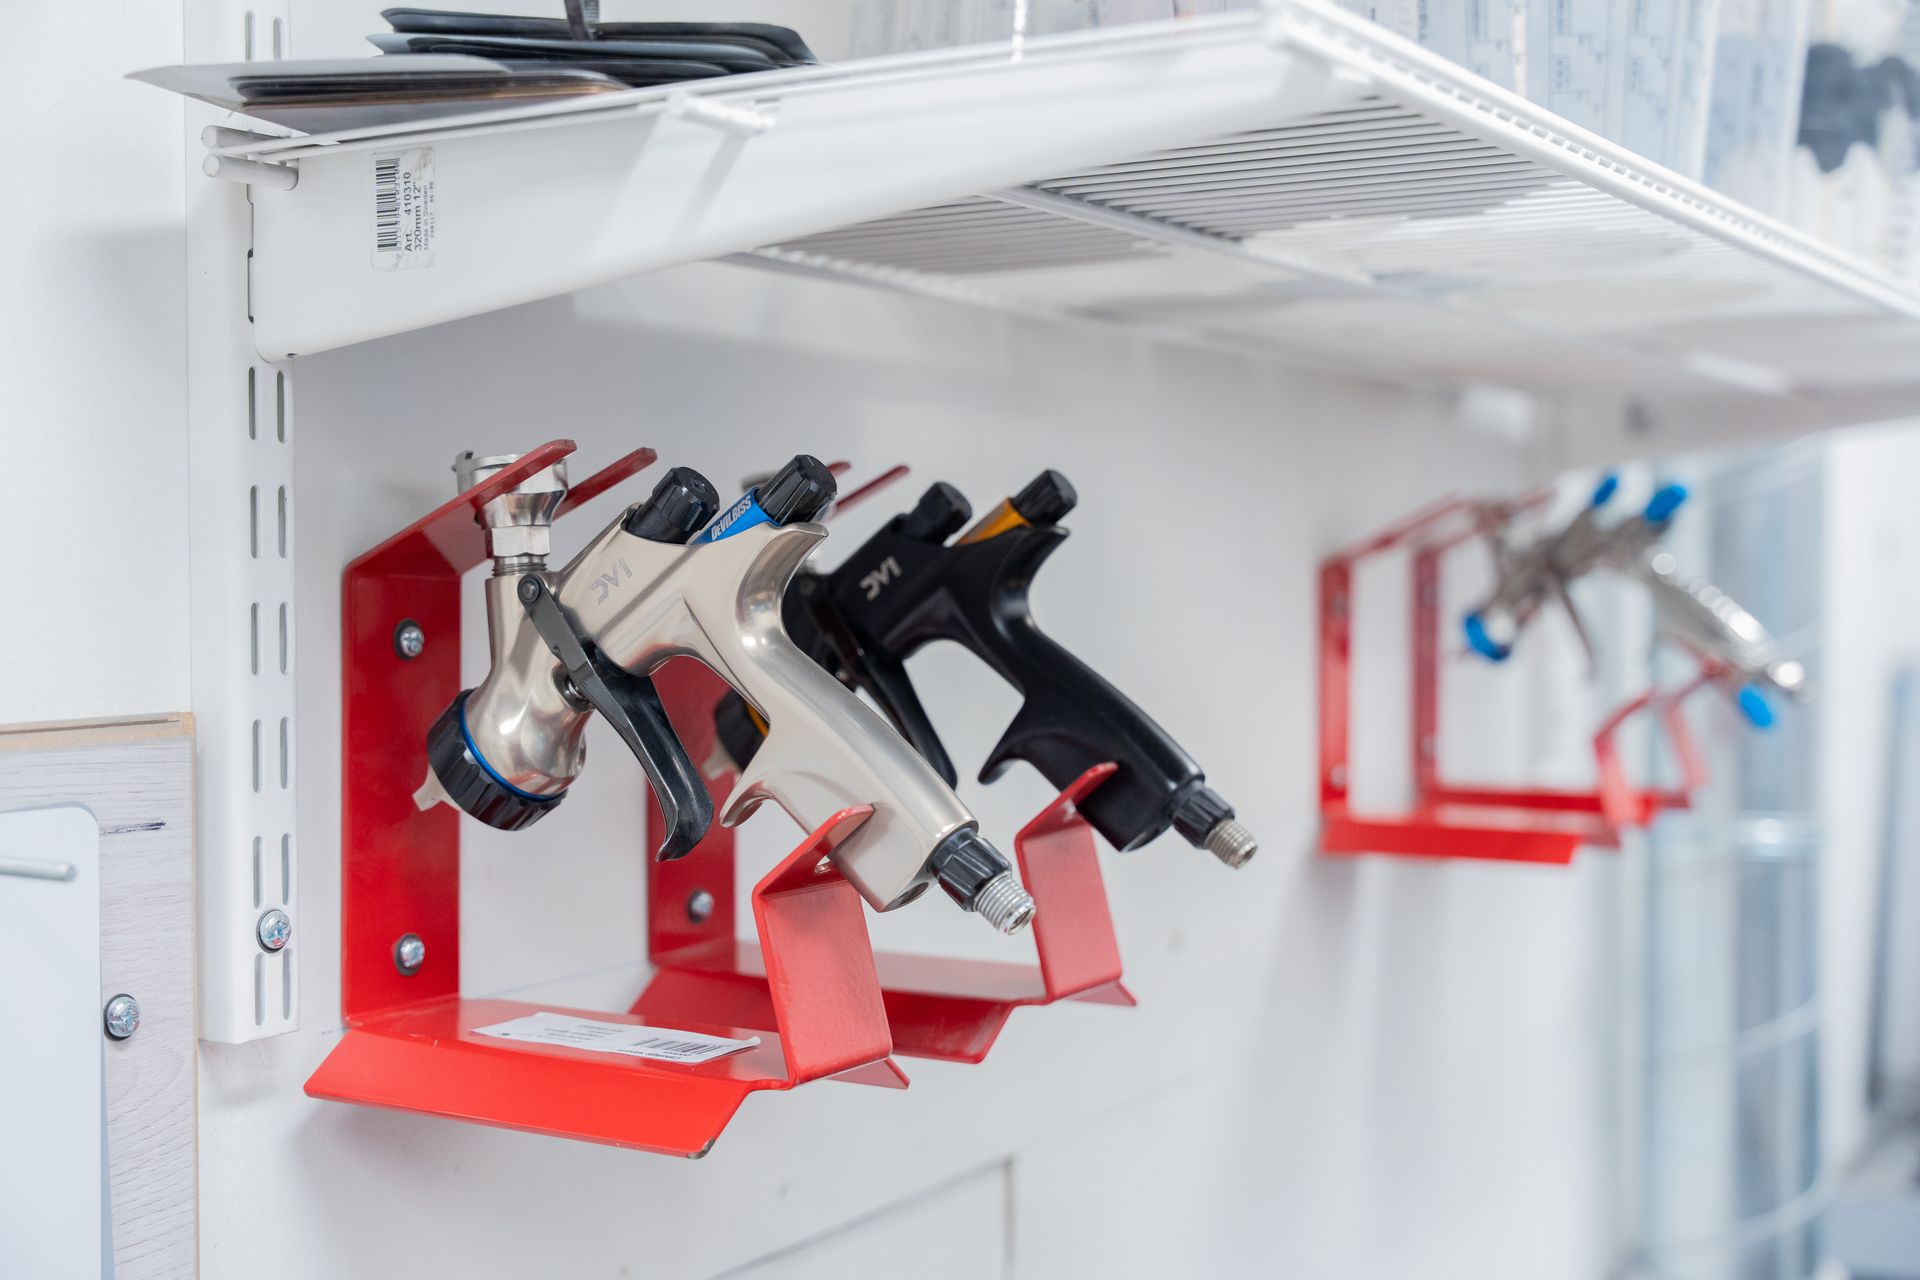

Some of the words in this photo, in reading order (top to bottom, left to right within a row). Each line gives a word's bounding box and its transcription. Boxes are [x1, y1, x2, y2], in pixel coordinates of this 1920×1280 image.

[403, 172, 412, 215] 410310
[404, 229, 413, 252] Art.
[413, 205, 422, 251] 320mm
